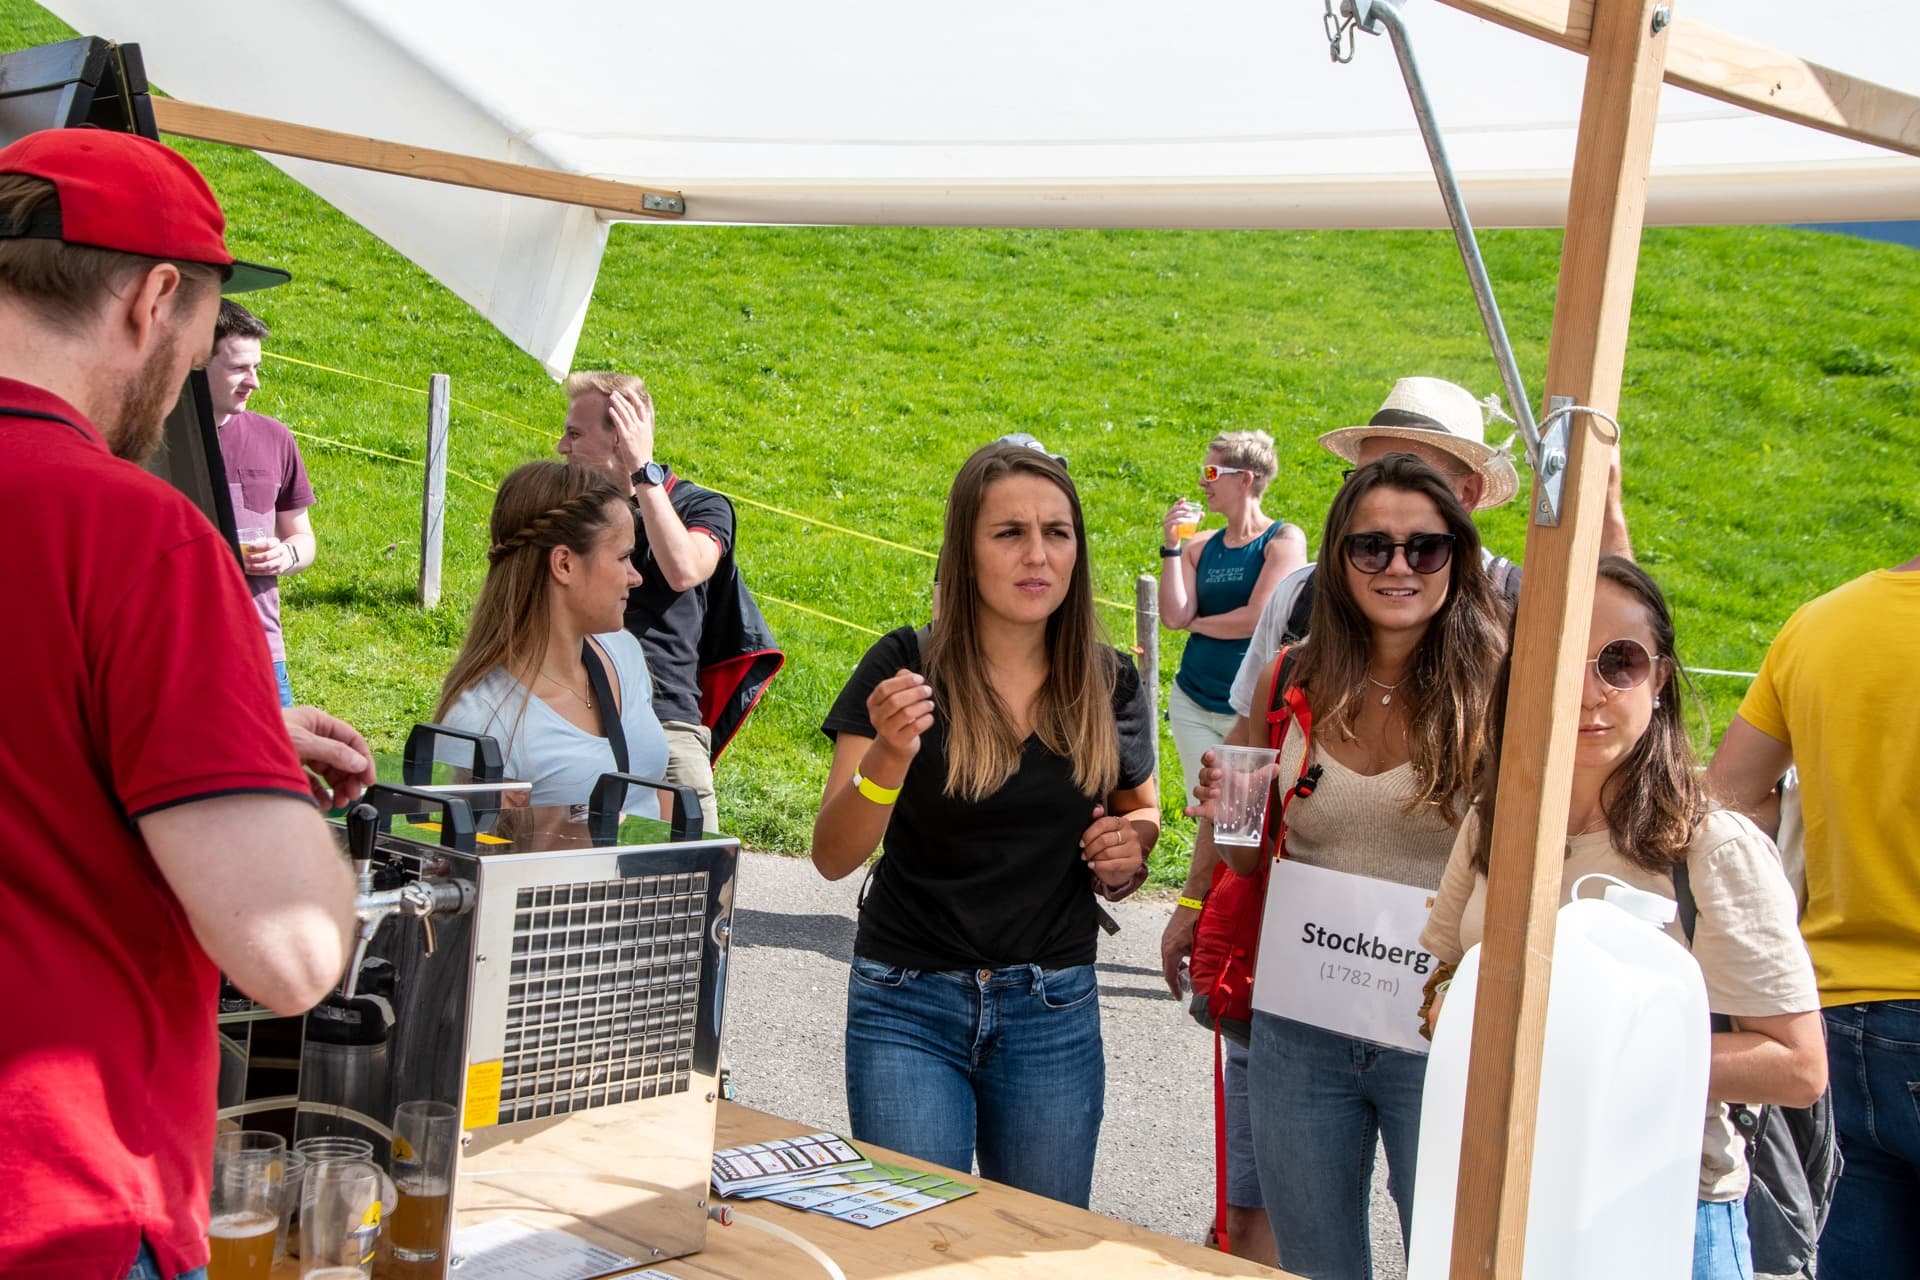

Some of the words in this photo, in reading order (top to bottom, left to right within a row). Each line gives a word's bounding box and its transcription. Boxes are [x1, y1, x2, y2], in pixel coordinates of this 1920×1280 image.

[1301, 922, 1431, 975] Stockberg
[1319, 961, 1372, 988] (1'782
[1376, 977, 1400, 997] m)
